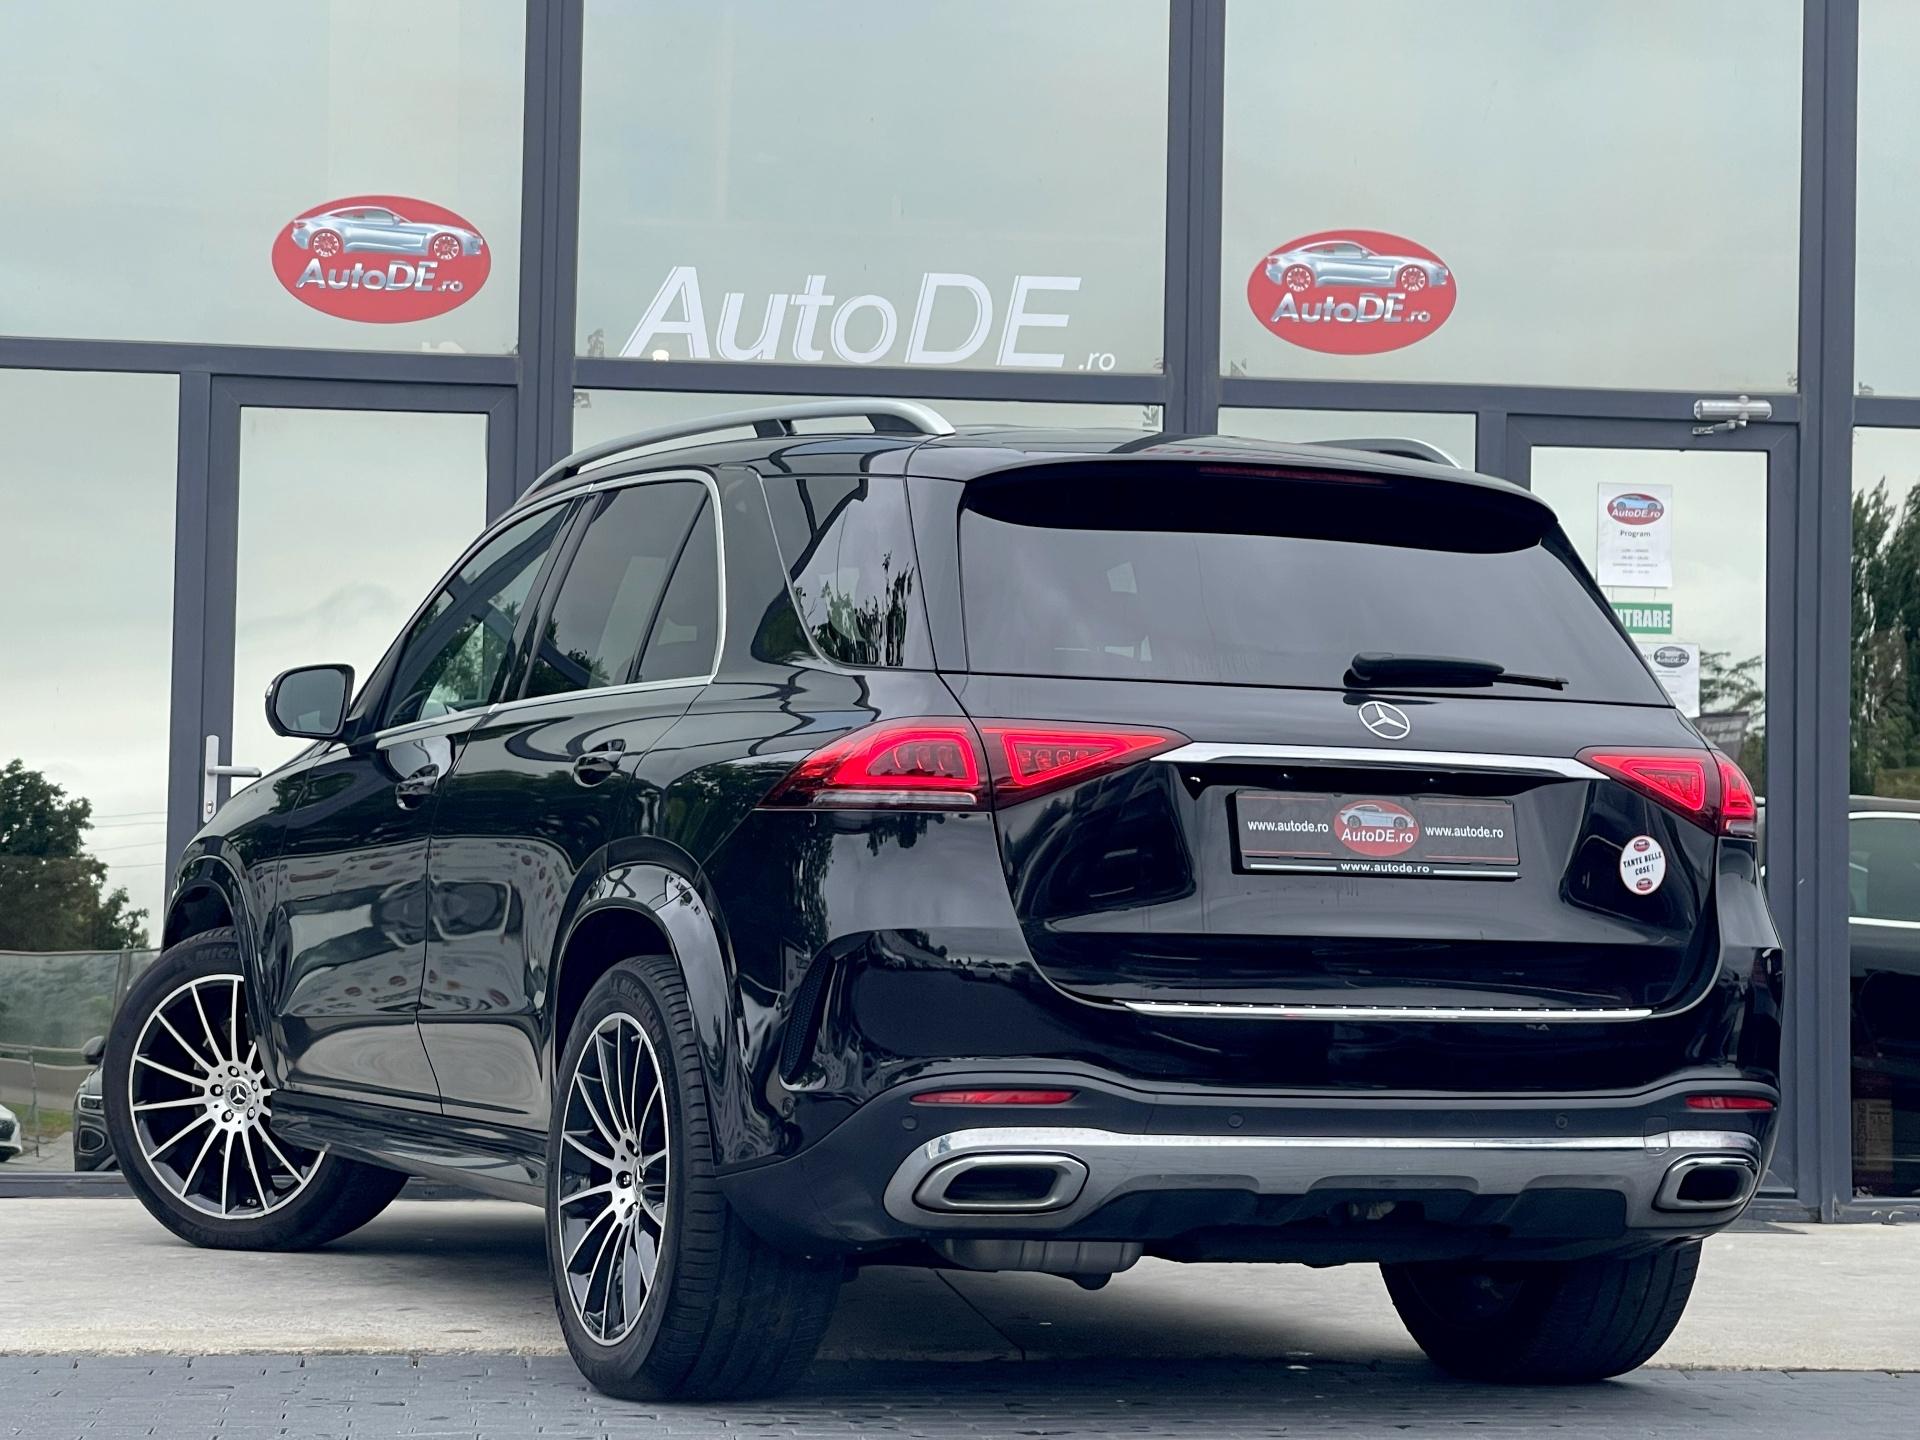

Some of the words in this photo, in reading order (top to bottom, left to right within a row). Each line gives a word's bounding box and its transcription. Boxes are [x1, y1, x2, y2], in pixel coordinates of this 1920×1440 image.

[1612, 508, 1660, 518] AutoDE.ro
[1619, 529, 1651, 538] Program
[1614, 609, 1671, 628] NTRARE
[1247, 819, 1329, 833] www.autode.ro
[1425, 825, 1504, 839] www.autode.ro
[1341, 828, 1414, 843] AutoDE.ro
[1340, 861, 1430, 874] www.autode.ro
[1623, 857, 1642, 868] TANTE
[1635, 865, 1650, 876] COSE
[196, 947, 238, 960] MICH
